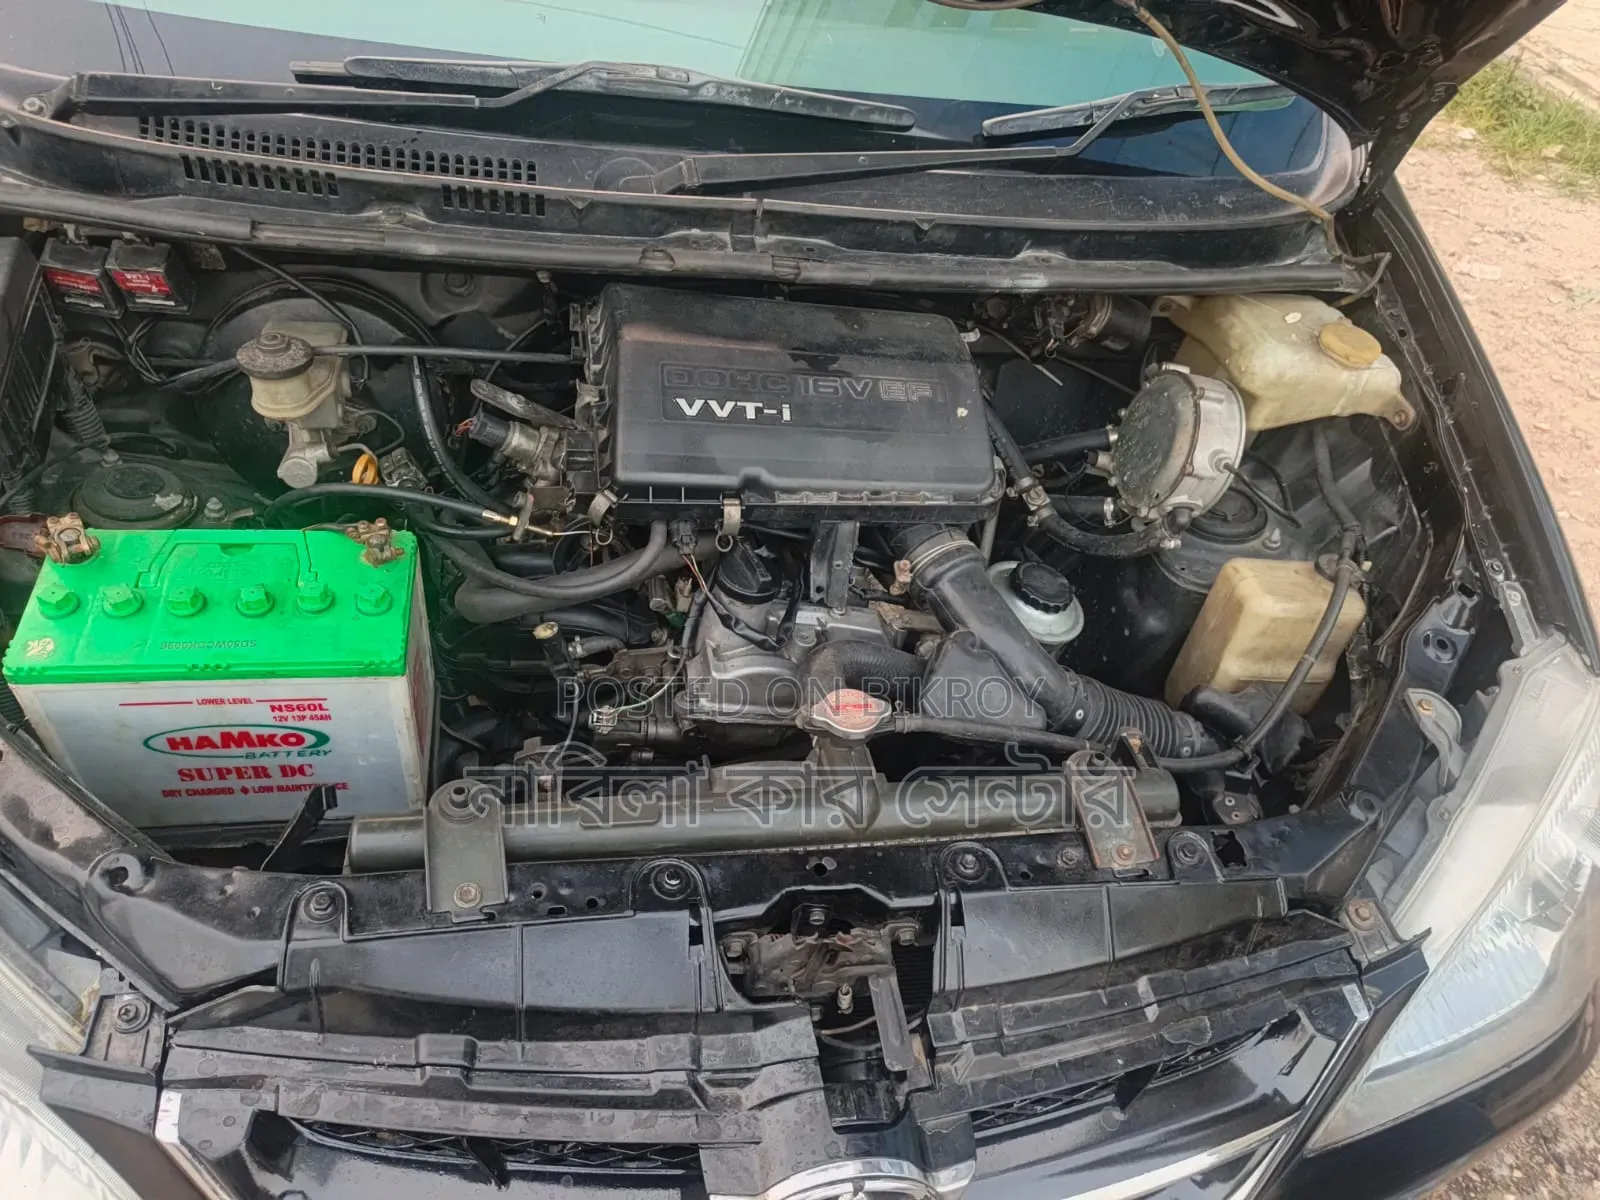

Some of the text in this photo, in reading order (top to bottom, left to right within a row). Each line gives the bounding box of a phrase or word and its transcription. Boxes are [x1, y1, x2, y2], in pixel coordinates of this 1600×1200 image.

[664, 366, 789, 393] DOHC
[800, 374, 873, 399] 16V
[675, 398, 792, 423] VVT-i
[196, 697, 254, 706] LOWER LEVEL
[269, 703, 329, 713] NS60L
[272, 714, 289, 723] 12V
[244, 748, 333, 760] BATTERY
[177, 763, 316, 782] SUPER DC
[161, 788, 183, 798] DRY
[185, 786, 236, 797] CHARGED
[253, 784, 275, 795] LOW
